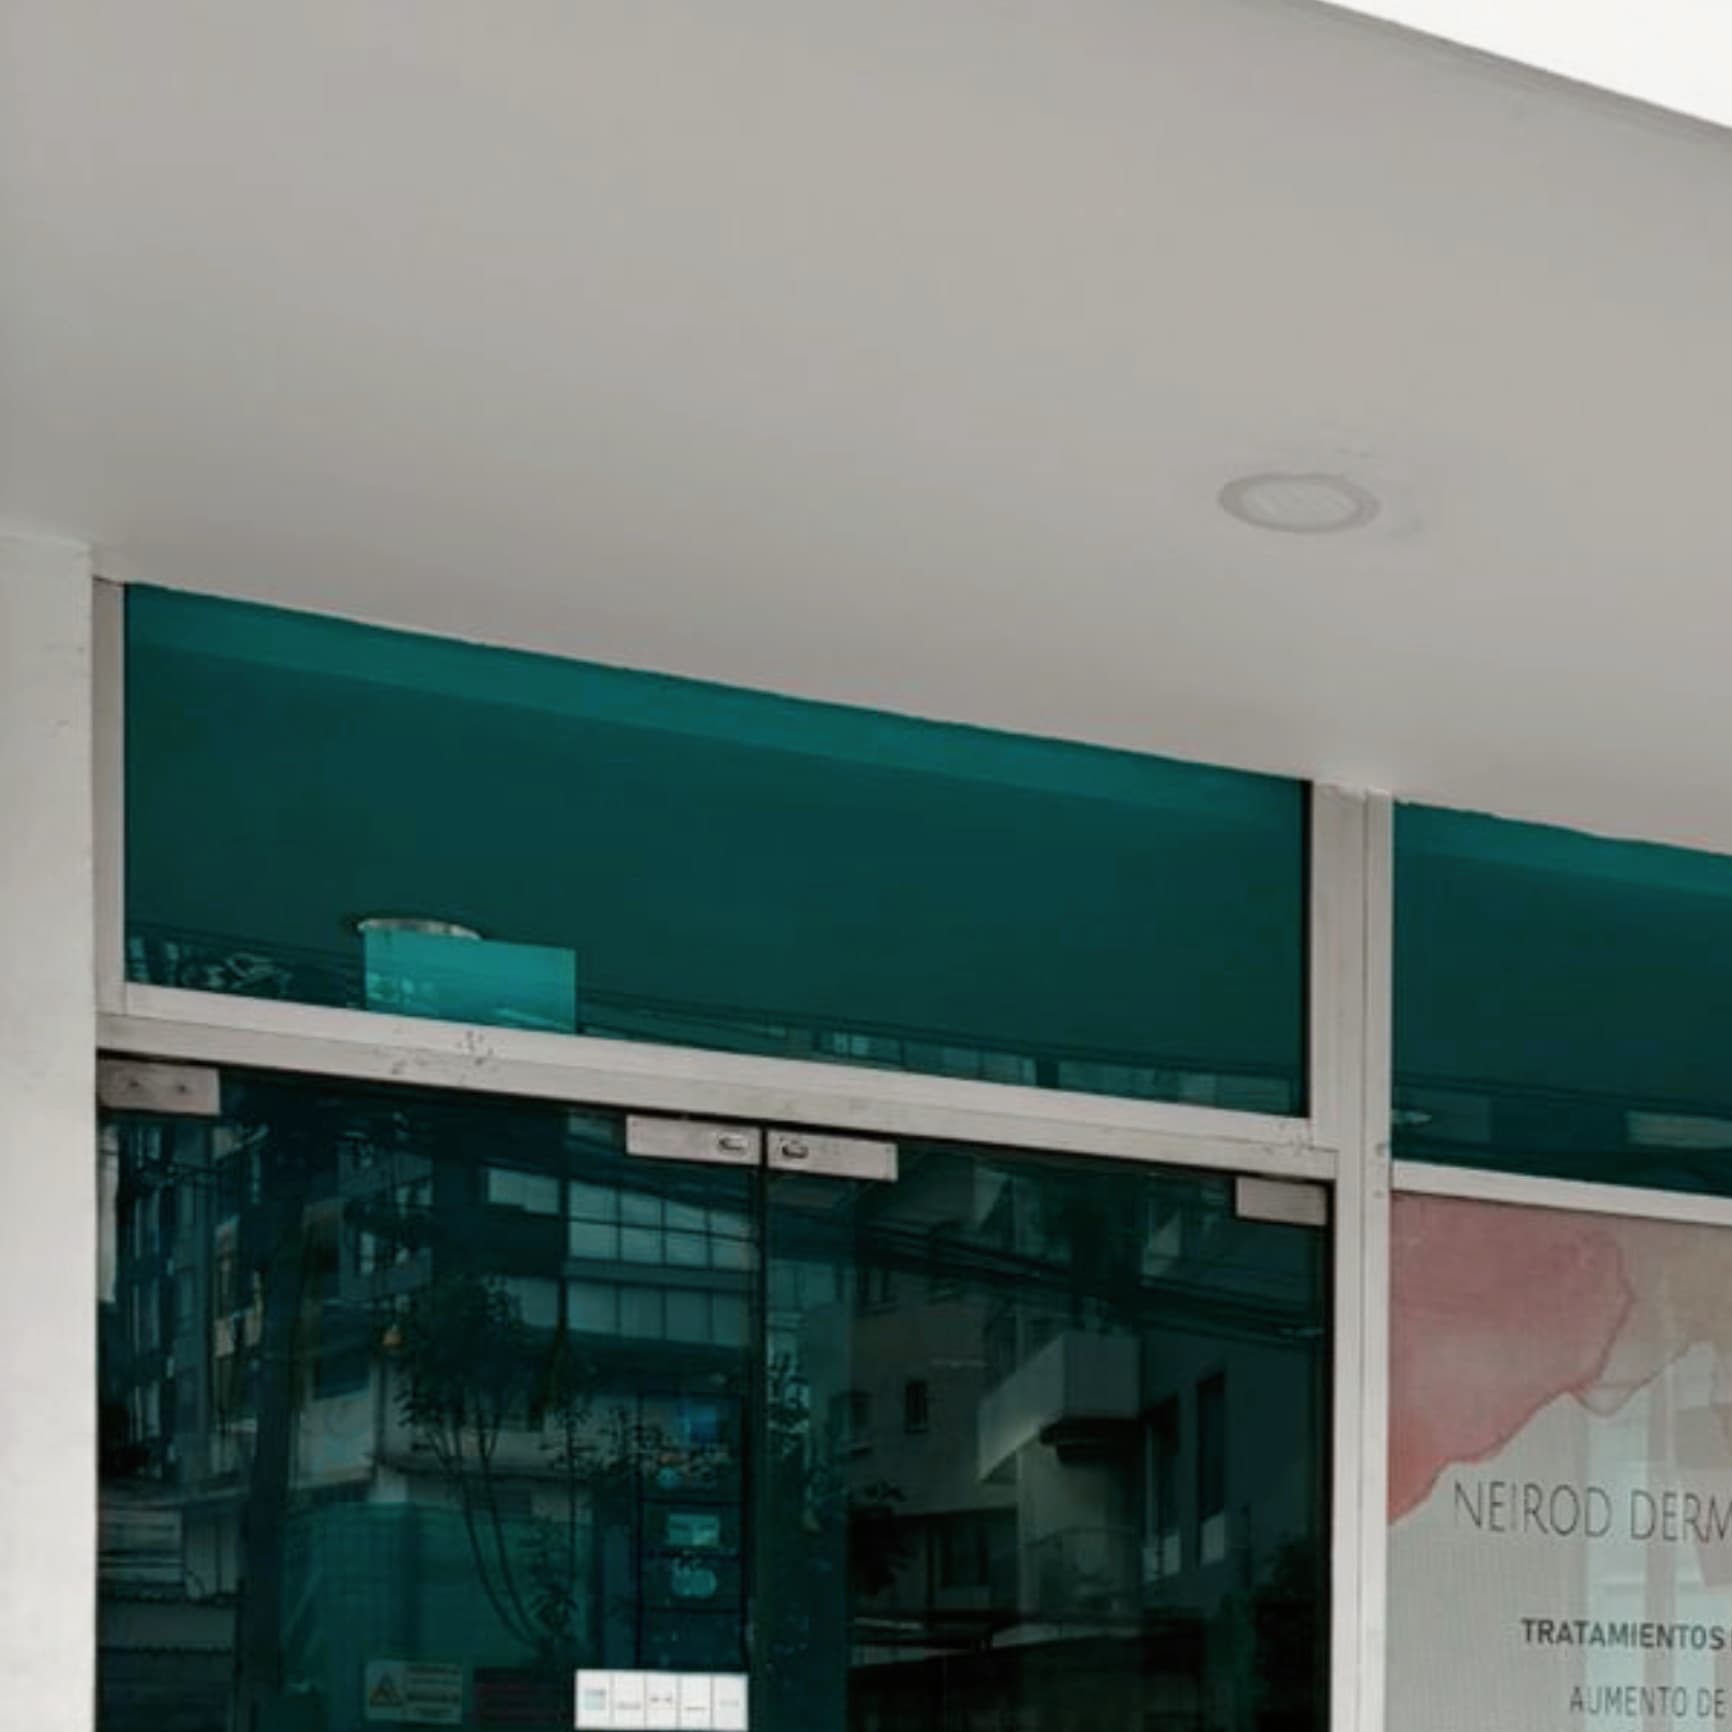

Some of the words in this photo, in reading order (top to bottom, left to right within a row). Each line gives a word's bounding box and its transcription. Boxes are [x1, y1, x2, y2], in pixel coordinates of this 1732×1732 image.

[1454, 1480, 1611, 1540] NEIROD
[1521, 1617, 1726, 1652] TRATAMIENTOS
[1570, 1685, 1687, 1718] AUMENTO
[1697, 1687, 1726, 1719] DE
